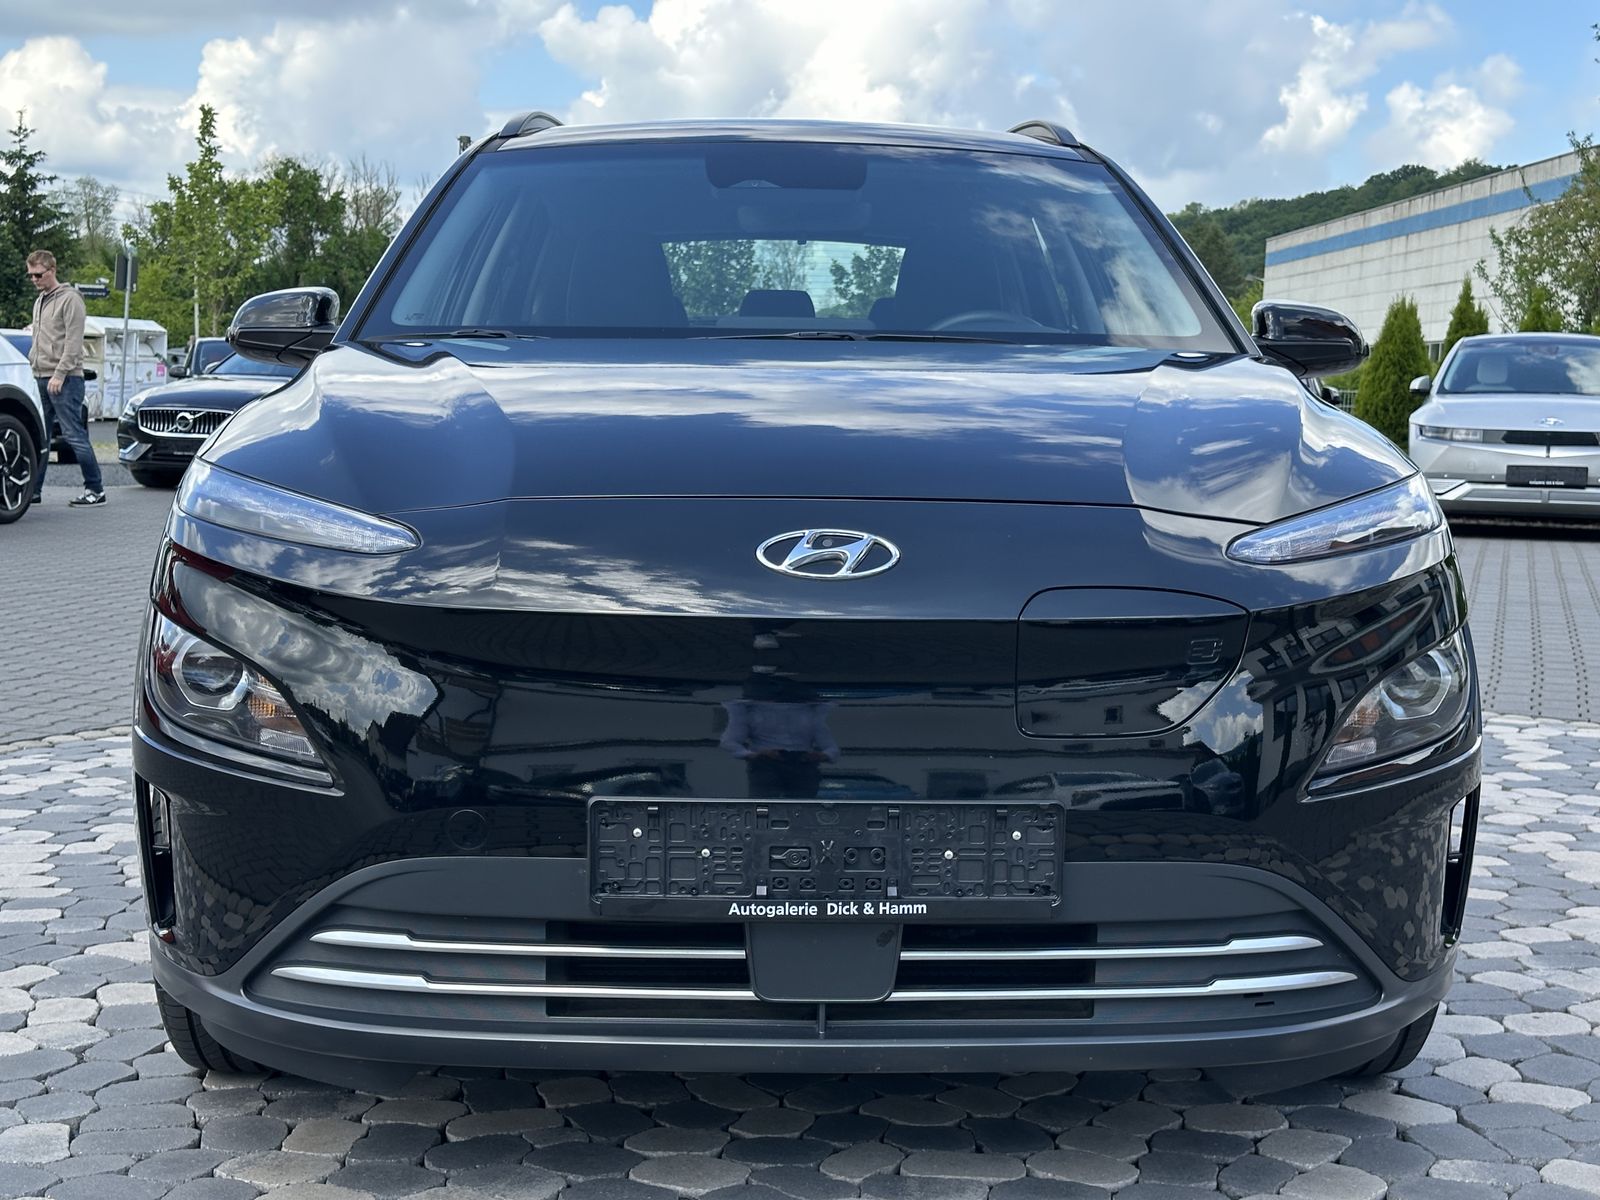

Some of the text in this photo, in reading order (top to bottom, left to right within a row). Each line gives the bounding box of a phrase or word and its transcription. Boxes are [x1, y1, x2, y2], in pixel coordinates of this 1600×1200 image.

[728, 901, 927, 917] Autogalerie Dick & Hamm
